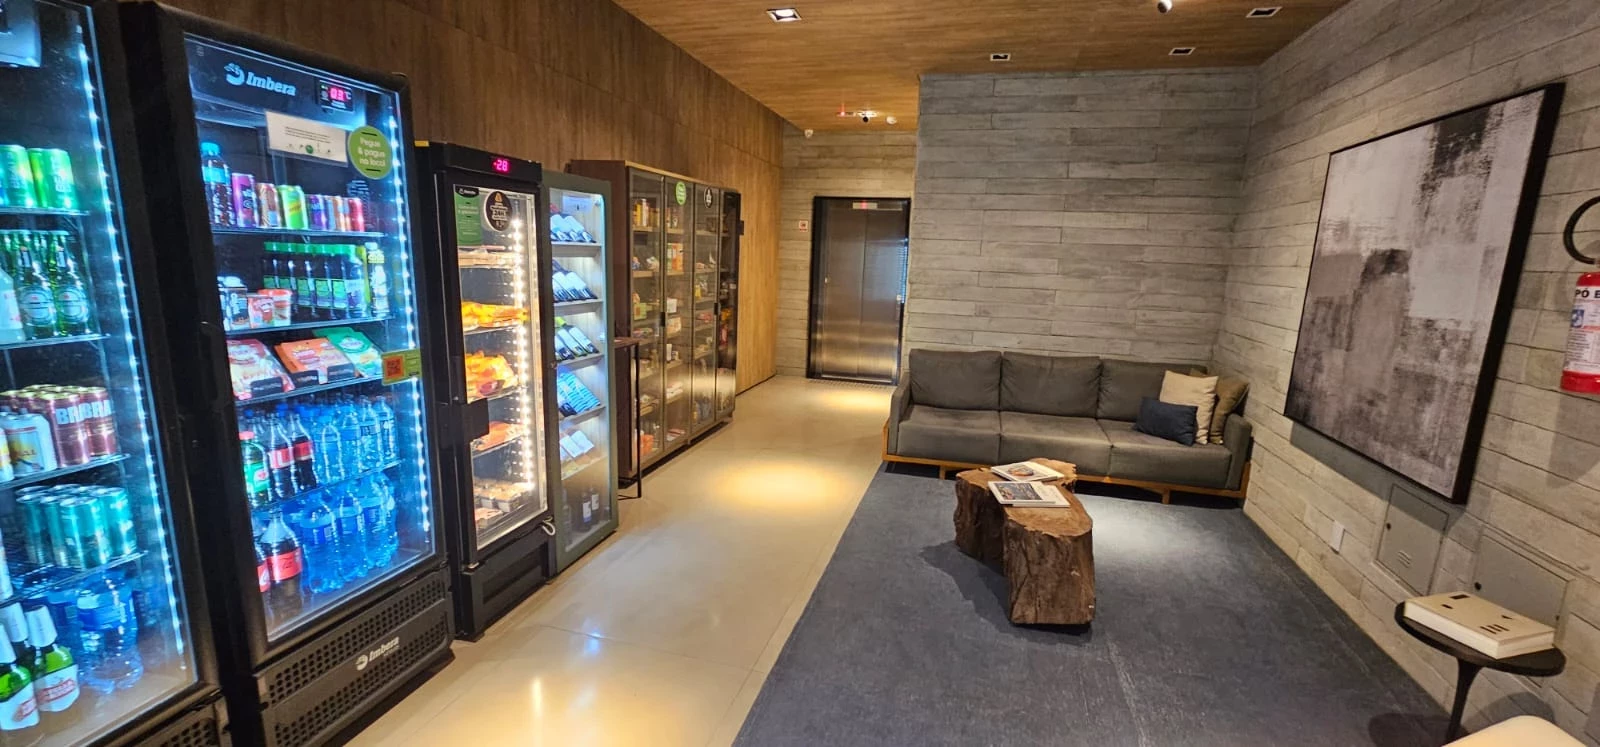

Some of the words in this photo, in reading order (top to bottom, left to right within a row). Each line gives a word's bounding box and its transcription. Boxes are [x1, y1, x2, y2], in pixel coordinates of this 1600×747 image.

[246, 71, 296, 96] Imbera
[1575, 287, 1590, 299] PÓ
[369, 636, 400, 662] Imbera
